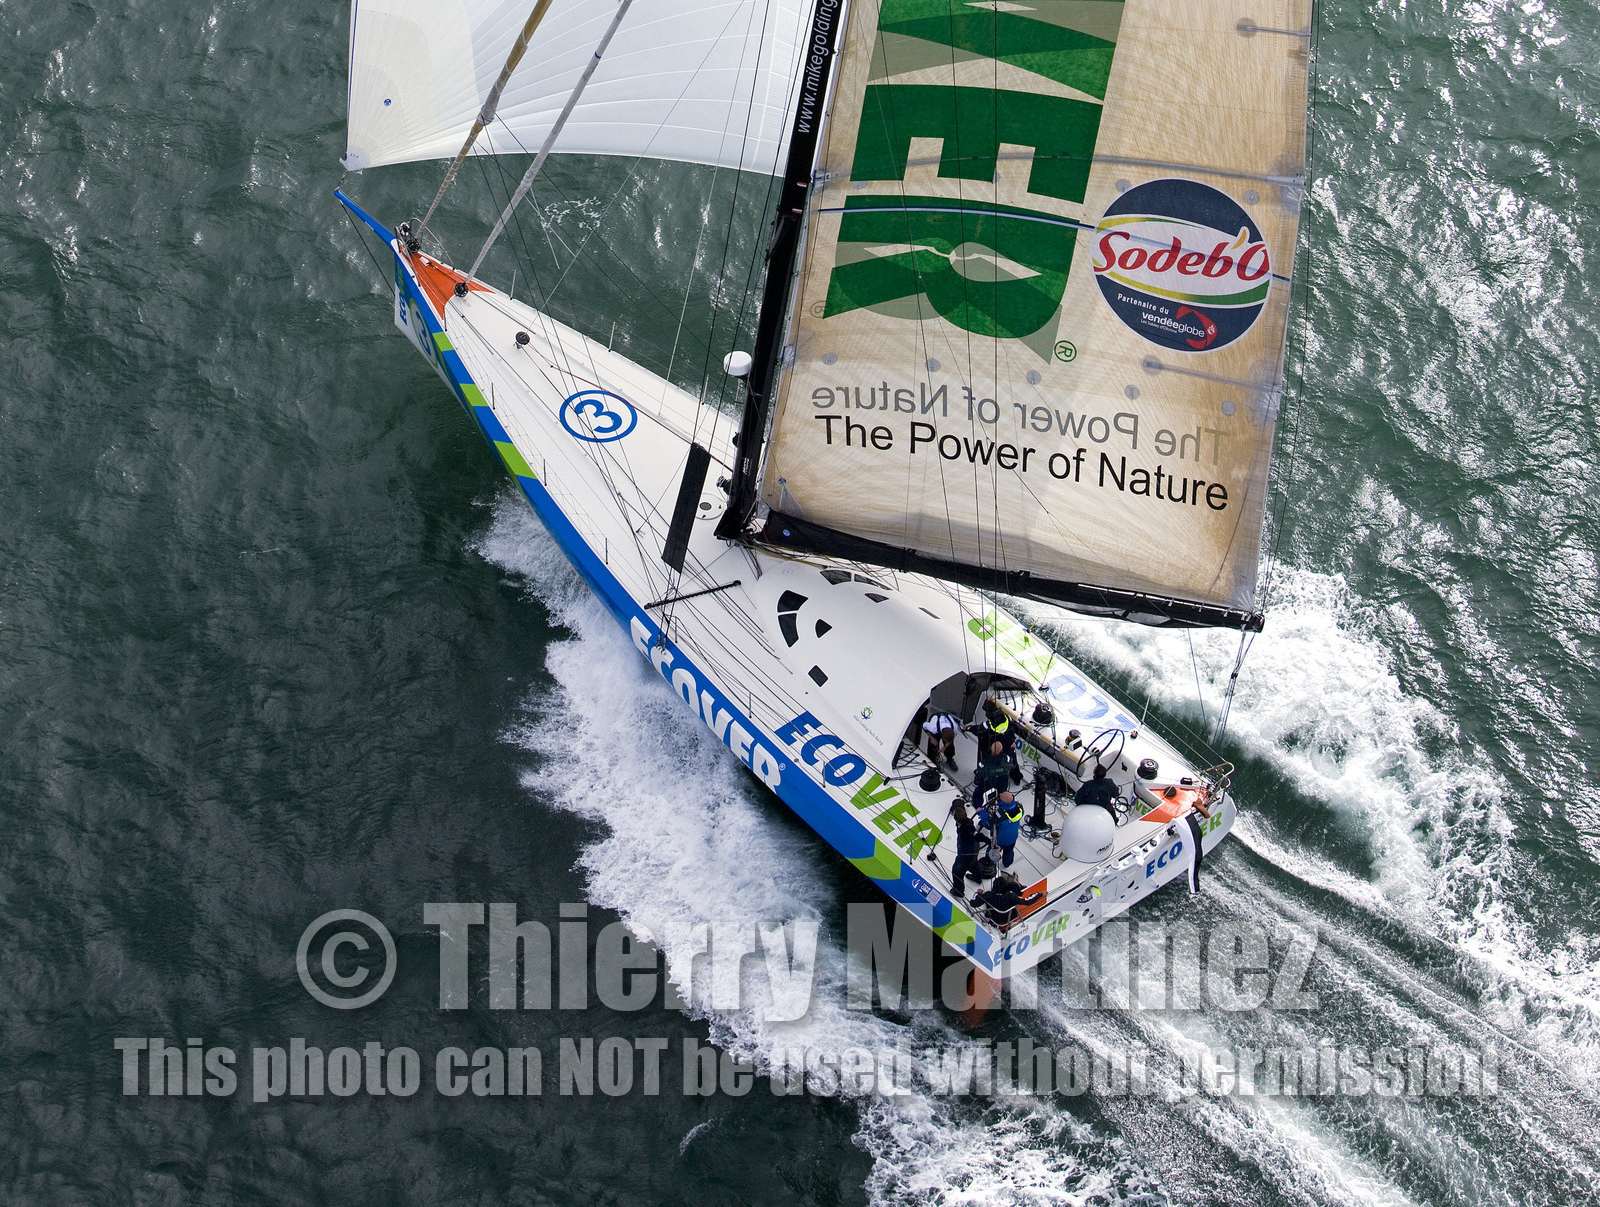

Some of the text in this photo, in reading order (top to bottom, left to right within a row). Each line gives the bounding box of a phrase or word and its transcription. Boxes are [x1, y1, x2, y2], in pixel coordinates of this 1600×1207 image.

[1117, 293, 1170, 315] Partenaire du
[574, 398, 623, 434] 3
[814, 415, 1229, 511] The Power of Nature
[773, 710, 944, 861] ECOVER
[993, 913, 1071, 968] ECOVER
